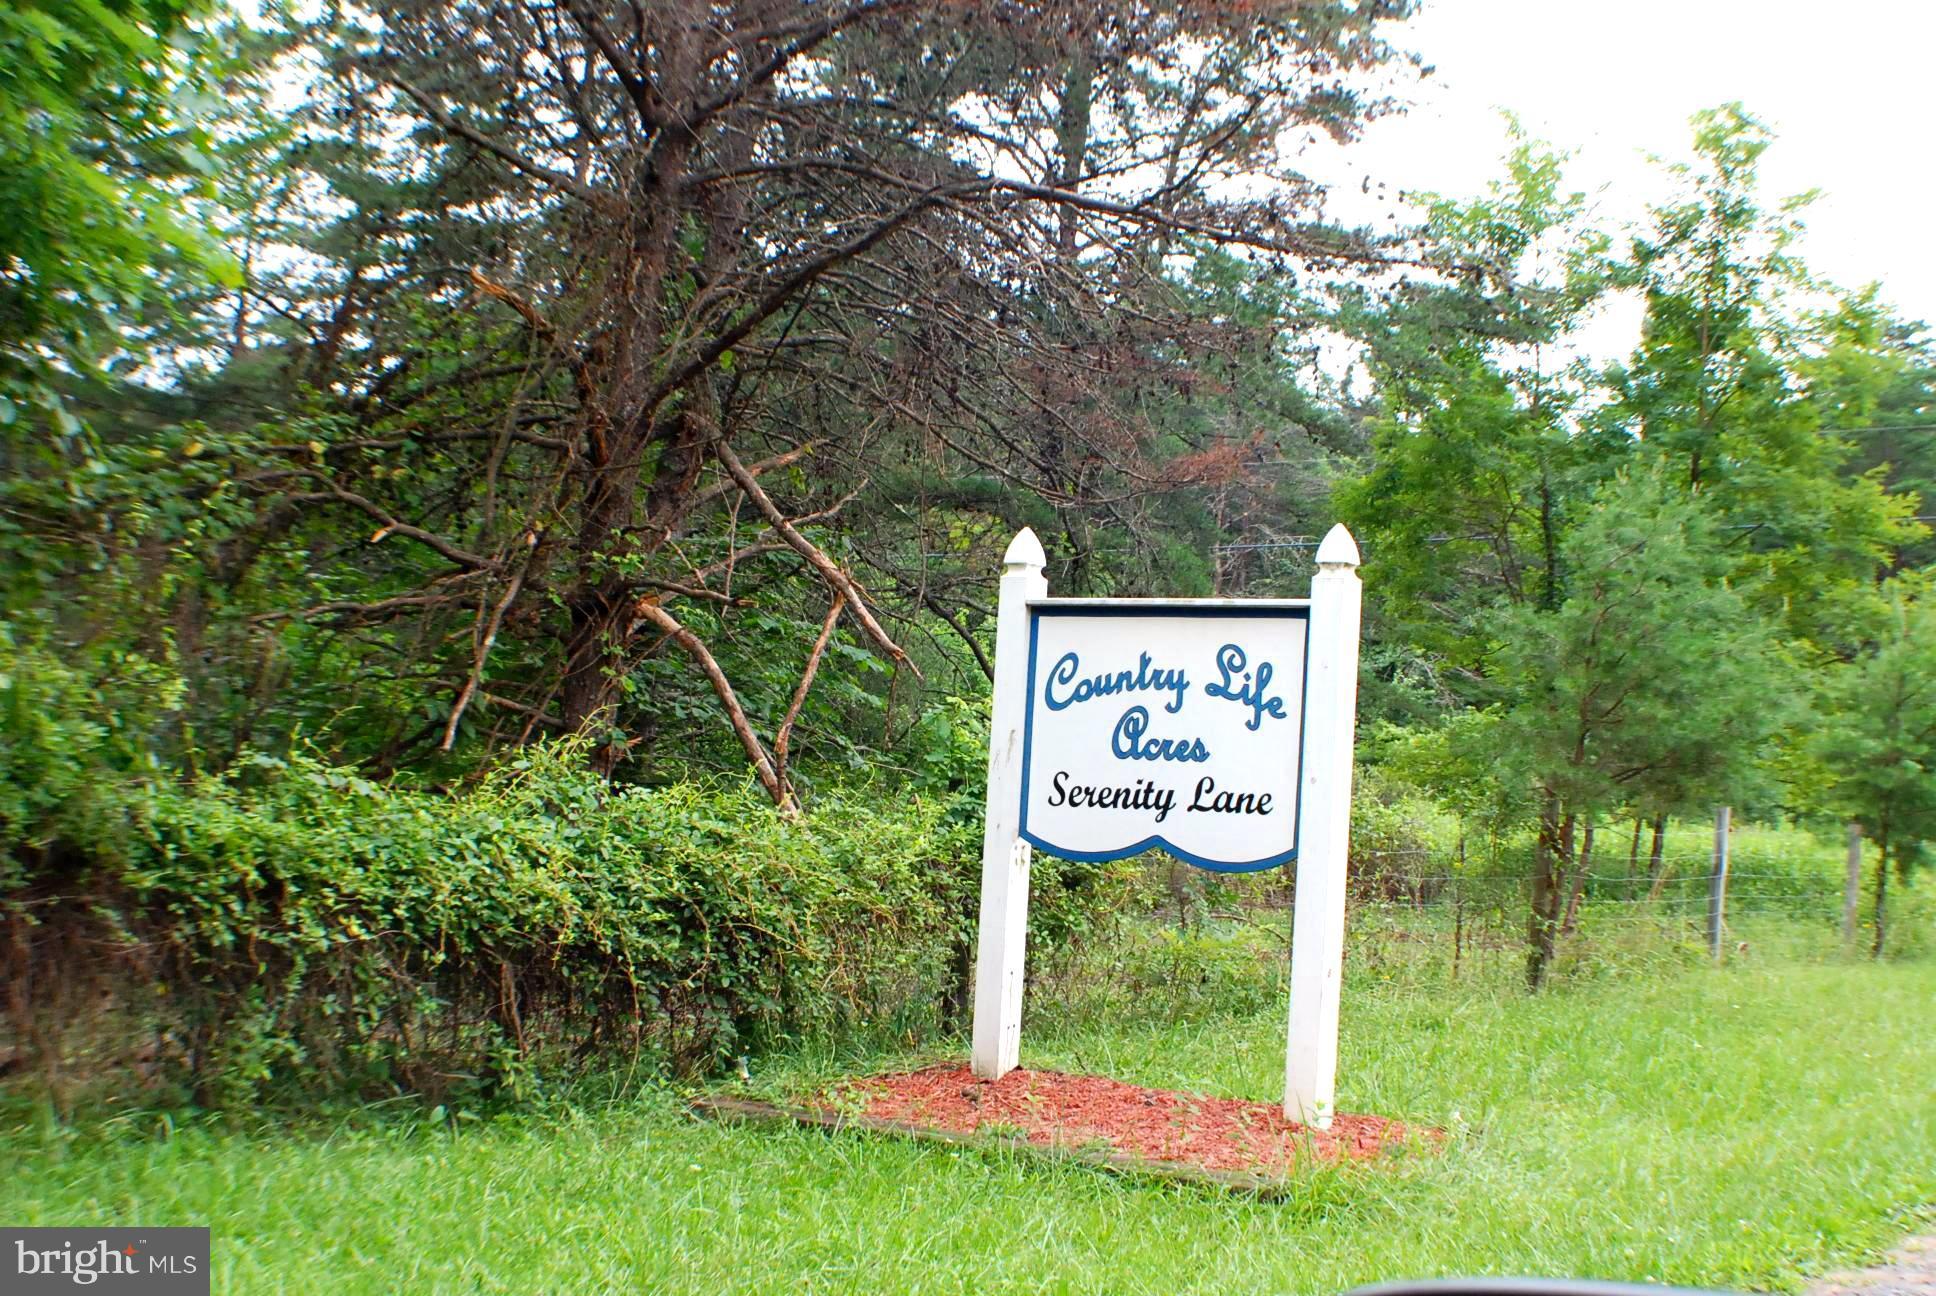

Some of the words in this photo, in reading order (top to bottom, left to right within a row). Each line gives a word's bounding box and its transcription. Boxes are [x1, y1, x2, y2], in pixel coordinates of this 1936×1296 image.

[1045, 651, 1191, 714] Country
[1205, 644, 1288, 731] Life
[1112, 705, 1211, 762] Acres
[1047, 770, 1177, 823] Serenity
[1186, 776, 1274, 816] Lane
